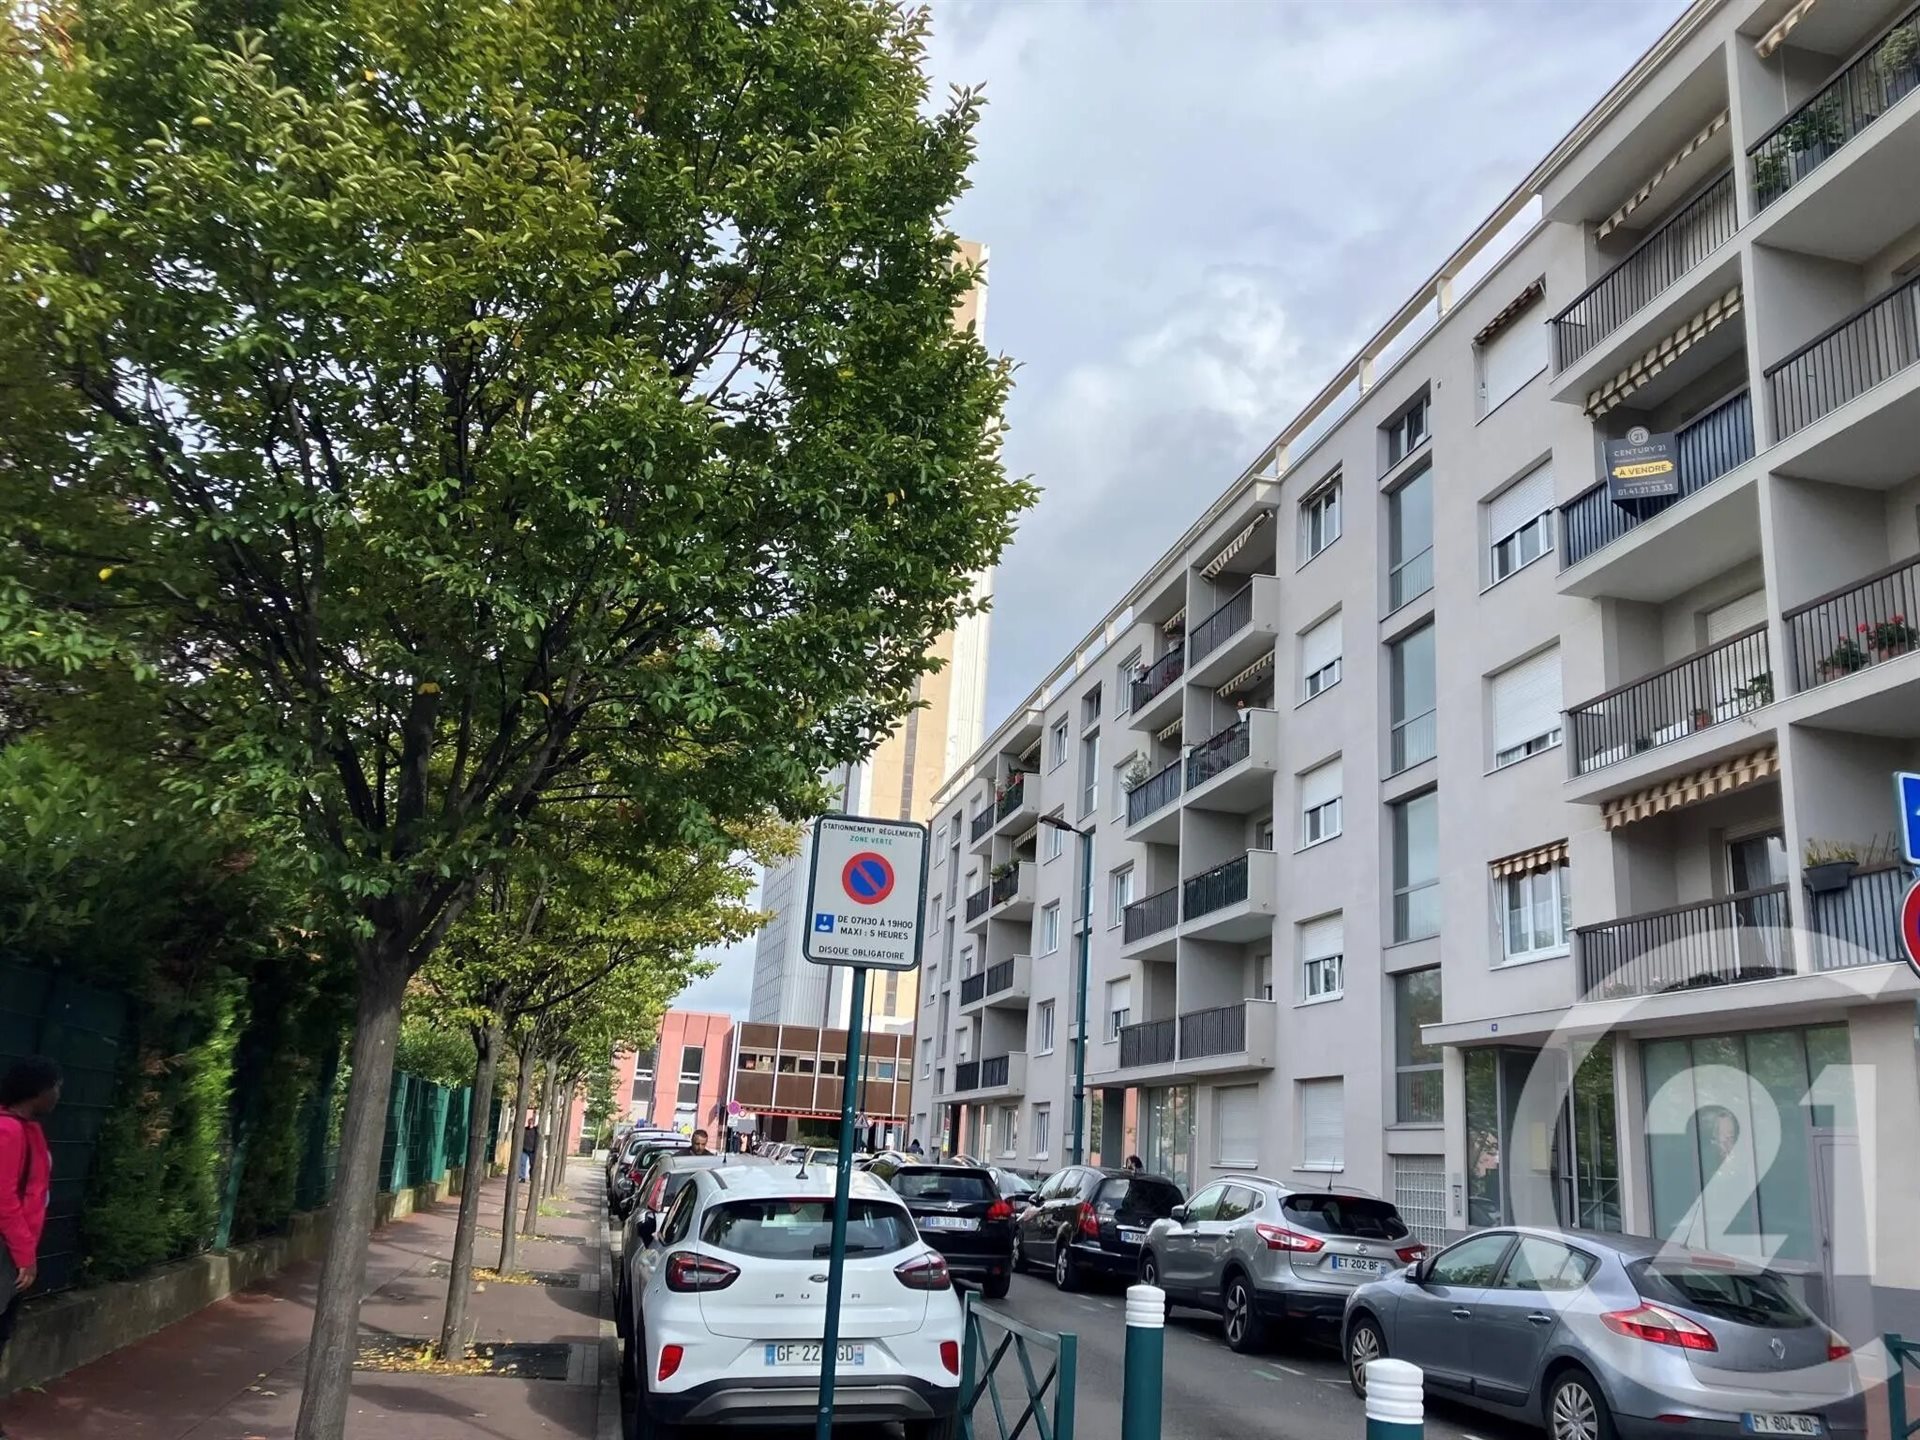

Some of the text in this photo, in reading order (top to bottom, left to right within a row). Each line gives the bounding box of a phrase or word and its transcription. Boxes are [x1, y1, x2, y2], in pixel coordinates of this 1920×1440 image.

[1614, 444, 1666, 457] CENTURY 21
[1629, 464, 1667, 475] VENDRE
[823, 823, 875, 834] STATIONNEMENT
[849, 835, 893, 846] ZONE VERTE
[837, 915, 849, 924] DE
[851, 916, 878, 926] 07H30
[888, 919, 913, 929] 19H00
[840, 927, 862, 936] MAXI
[870, 929, 875, 937] 5
[878, 930, 909, 940] HEURES
[818, 945, 905, 960] DISQUE OBLIGATOIRE
